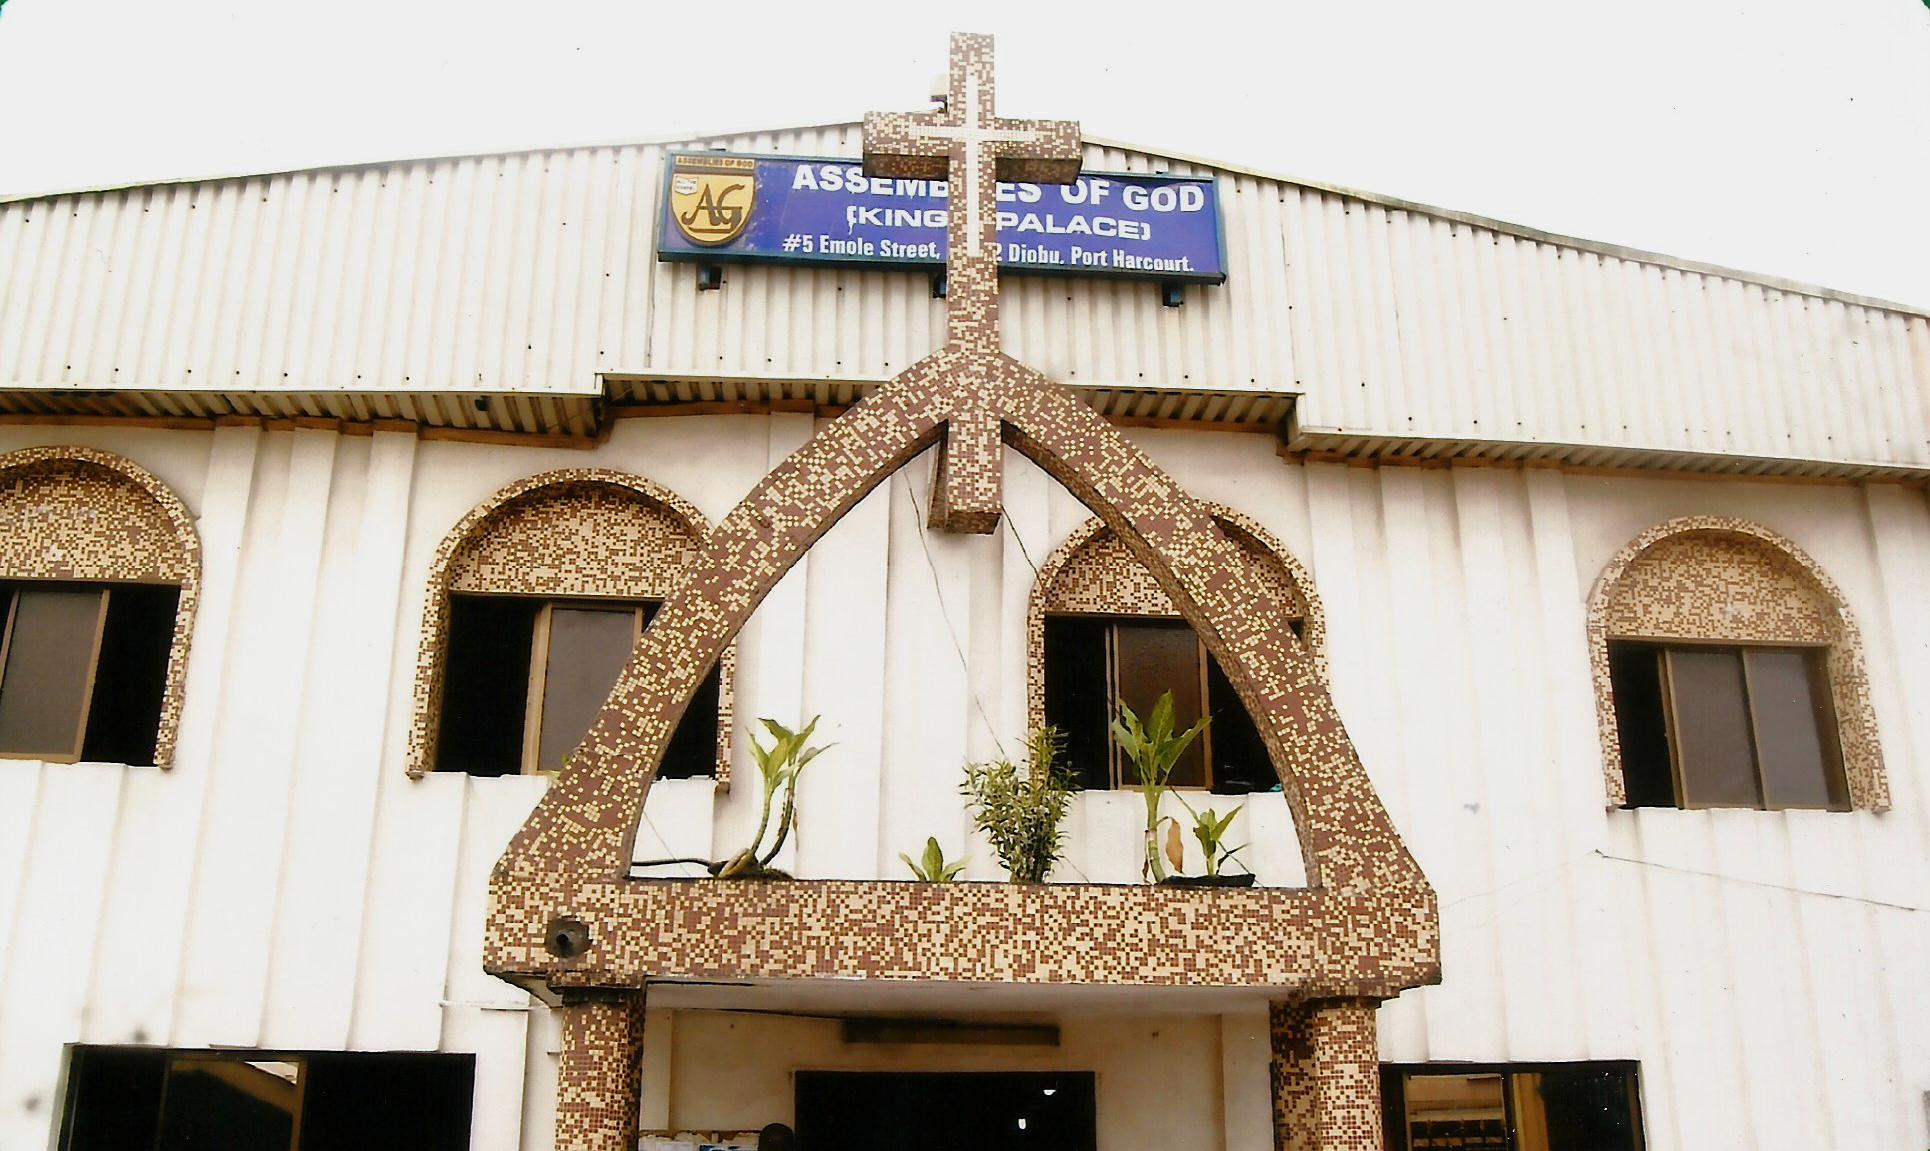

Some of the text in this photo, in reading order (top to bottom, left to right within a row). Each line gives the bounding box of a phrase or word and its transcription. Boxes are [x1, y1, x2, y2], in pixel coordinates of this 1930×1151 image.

[792, 164, 1205, 212] ASSEMBES OF GOD
[782, 233, 814, 253] #5
[819, 234, 874, 256] Emole
[879, 239, 941, 260] Street,
[1008, 243, 1065, 264] Diobu.
[1071, 245, 1108, 267] Port
[1112, 249, 1195, 272] Harcourt.
